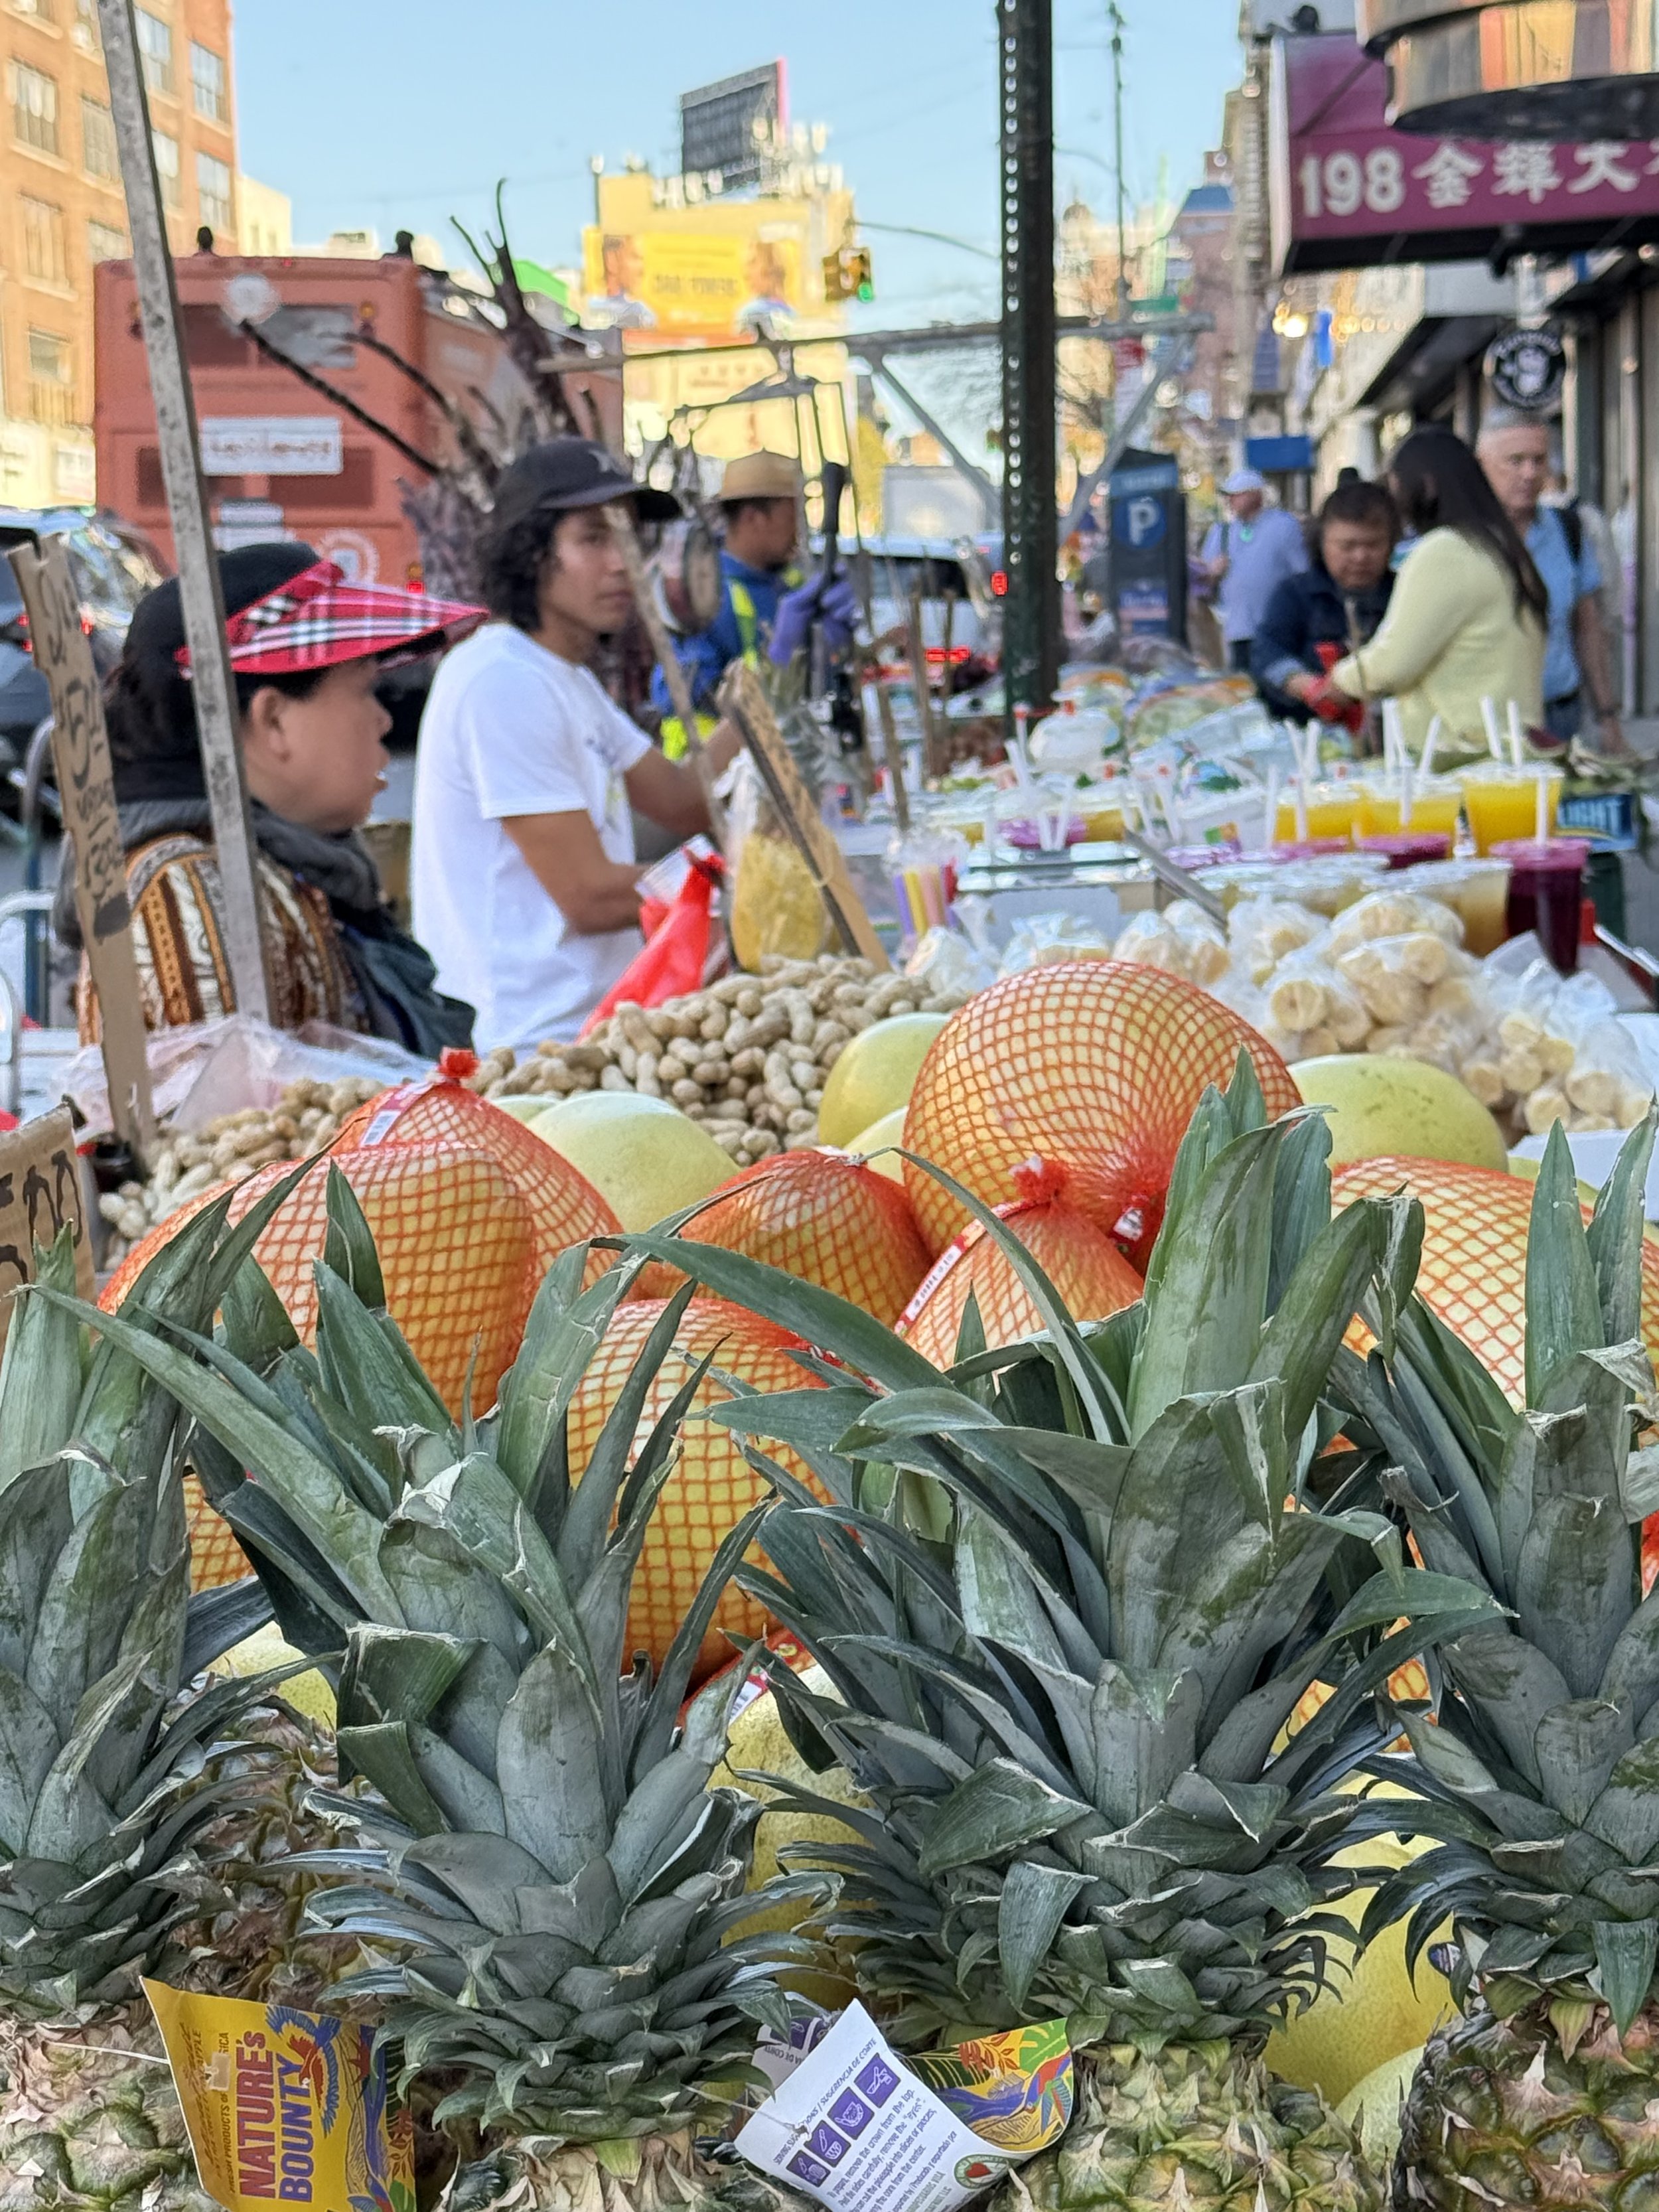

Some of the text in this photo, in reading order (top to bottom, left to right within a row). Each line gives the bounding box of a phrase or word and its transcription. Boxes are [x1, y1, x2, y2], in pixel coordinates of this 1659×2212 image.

[1299, 144, 1406, 219] 198
[1130, 500, 1161, 546] P
[220, 2105, 232, 2158] PRODUCTS
[276, 2051, 315, 2203] BOUNTY
